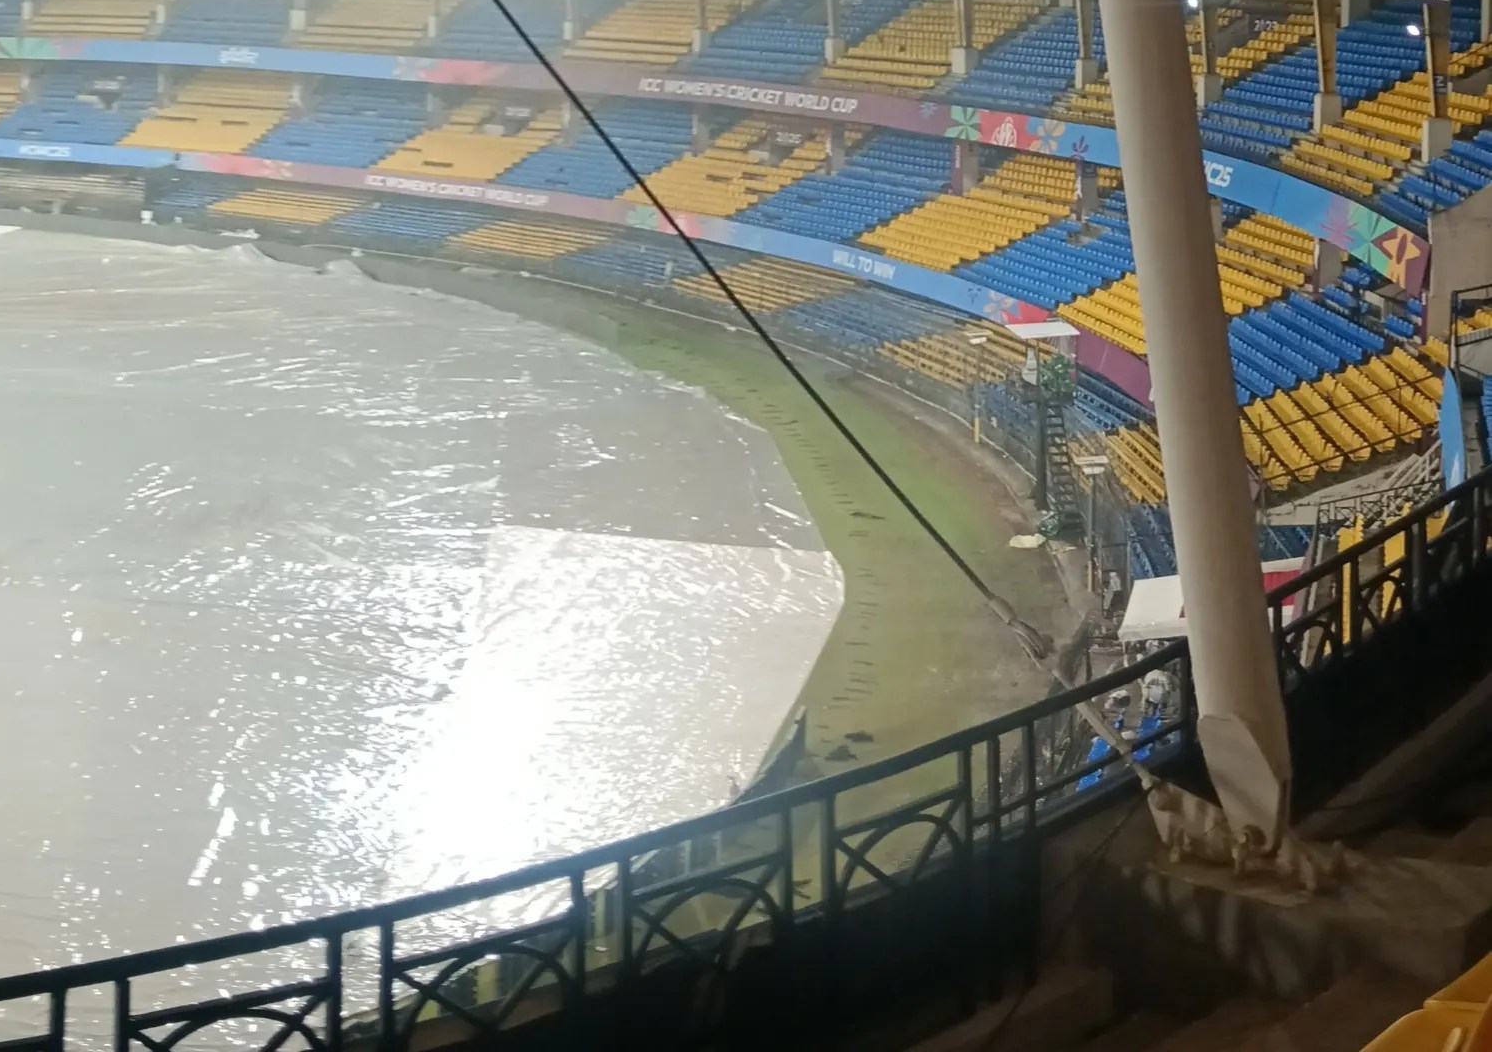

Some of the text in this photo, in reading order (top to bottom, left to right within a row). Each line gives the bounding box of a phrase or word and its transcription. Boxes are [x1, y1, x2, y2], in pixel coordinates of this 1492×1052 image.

[637, 77, 858, 114] ICC WOMEN'S CRICKET WORLD CUP
[857, 255, 873, 273] TO
